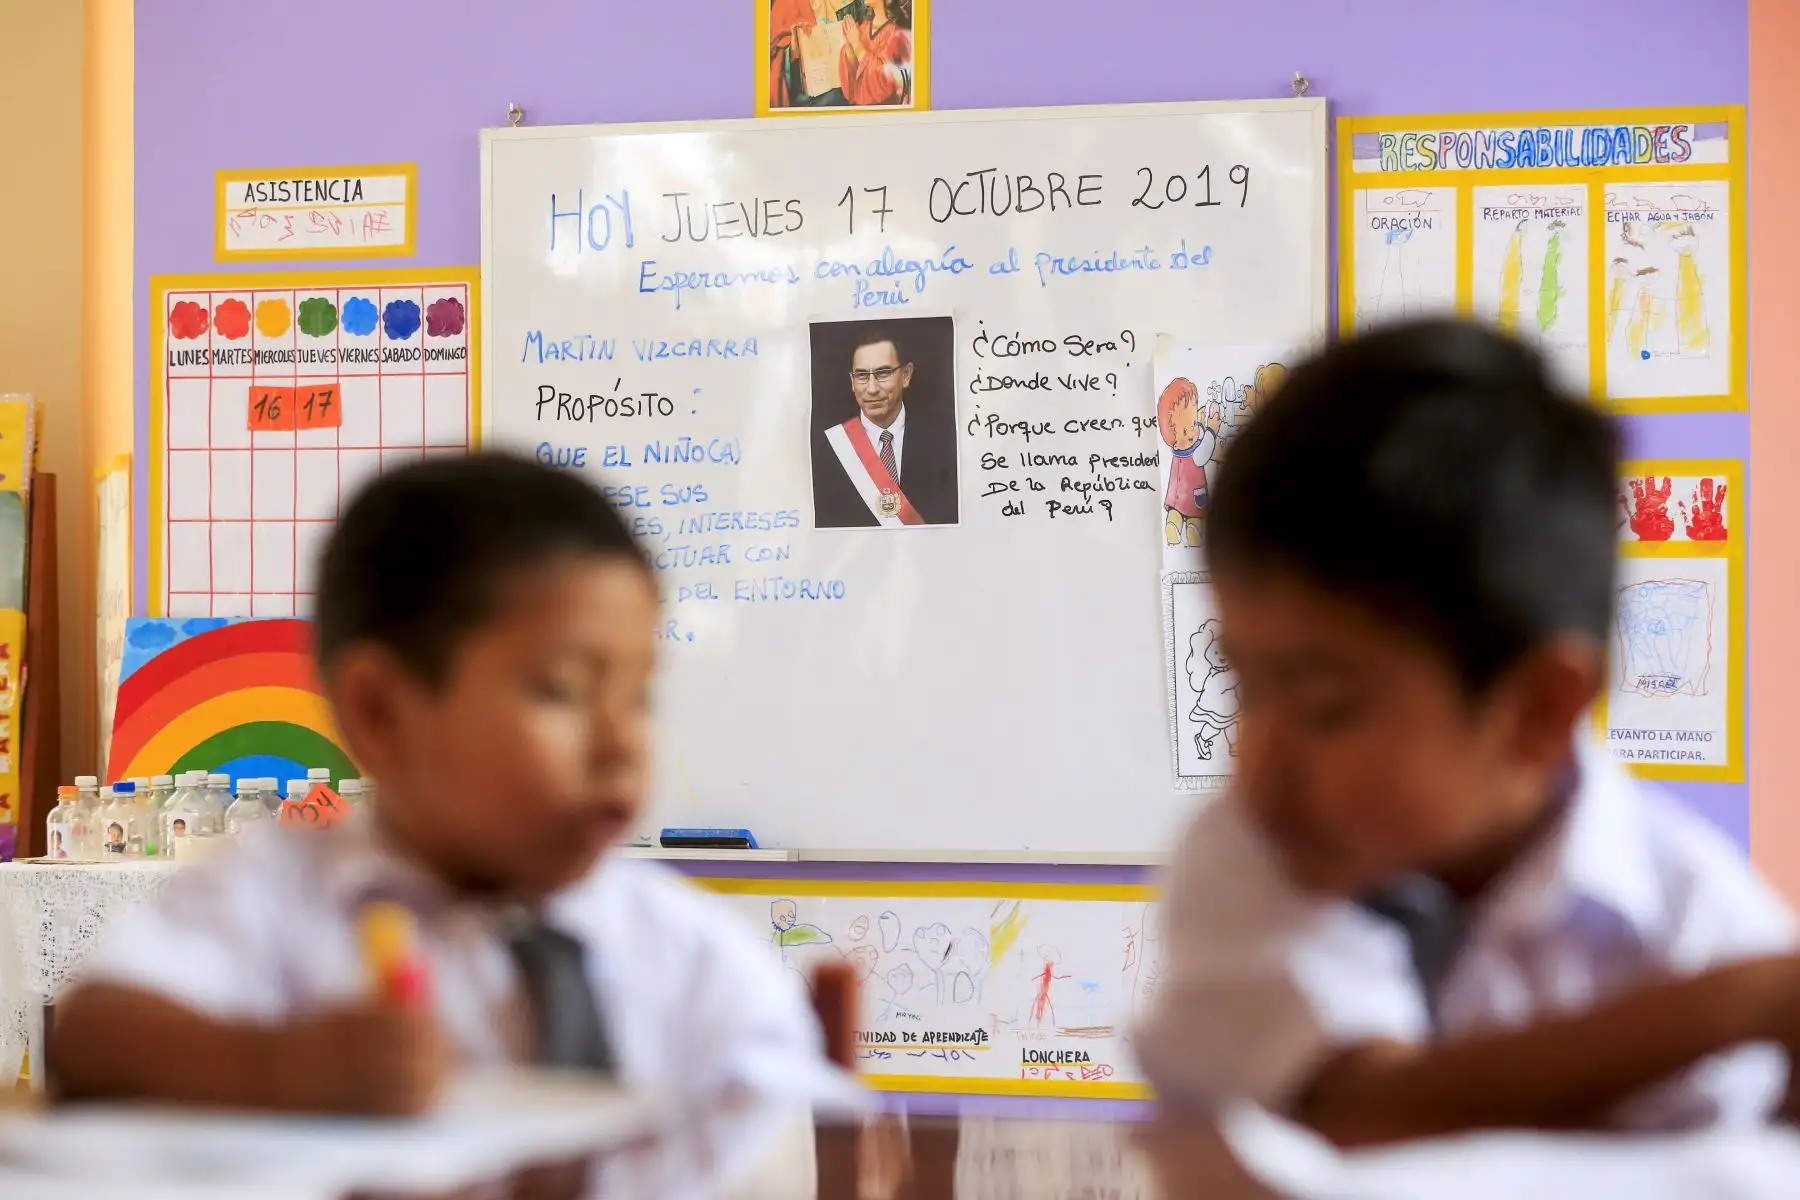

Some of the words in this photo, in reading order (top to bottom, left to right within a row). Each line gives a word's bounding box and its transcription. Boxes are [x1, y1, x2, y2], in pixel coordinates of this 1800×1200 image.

[1379, 125, 1692, 172] RESPONSABILIDADES
[244, 179, 363, 203] ASISTENCIA
[551, 188, 634, 253] HOY
[662, 193, 804, 243] JUEVES
[838, 185, 893, 235] 17
[929, 168, 1103, 223] OCTUBRE
[1132, 164, 1250, 209] 2019
[1483, 208, 1530, 221] REPARTO
[1607, 211, 1640, 222] ECHAR
[1647, 212, 1671, 221] AGUA
[639, 260, 801, 310] Esperamos
[989, 248, 1021, 275] al
[170, 349, 209, 367] LUNES
[212, 348, 252, 365] MARTES
[254, 349, 296, 366] MIERCOLES
[297, 348, 336, 363] JUEVES
[339, 347, 380, 363] VIERNES
[381, 347, 421, 363] SABADO
[424, 346, 467, 362] DOMINGO
[632, 337, 758, 362] VIZCARRA
[254, 393, 280, 422] 16
[303, 390, 333, 420] 17
[603, 444, 631, 467] EL
[981, 452, 1009, 470] Se
[1020, 452, 1078, 467] llama
[1089, 449, 1159, 473] president
[660, 484, 709, 505] SUS
[981, 480, 1020, 497] De
[1026, 477, 1045, 491] la
[1001, 500, 1025, 517] del
[679, 510, 800, 535] INTERESES
[744, 544, 790, 562] CON
[678, 582, 718, 603] DEL
[735, 576, 845, 603] ENTORNO
[1660, 731, 1672, 741] LA
[1676, 731, 1712, 742] MANO
[1637, 749, 1706, 761] PARTICIPAR.
[852, 1030, 897, 1042] TIVIDAD
[902, 1031, 917, 1042] DE
[922, 1027, 989, 1045] APRENDIZAJE
[1022, 1047, 1090, 1063] LONCHERA
